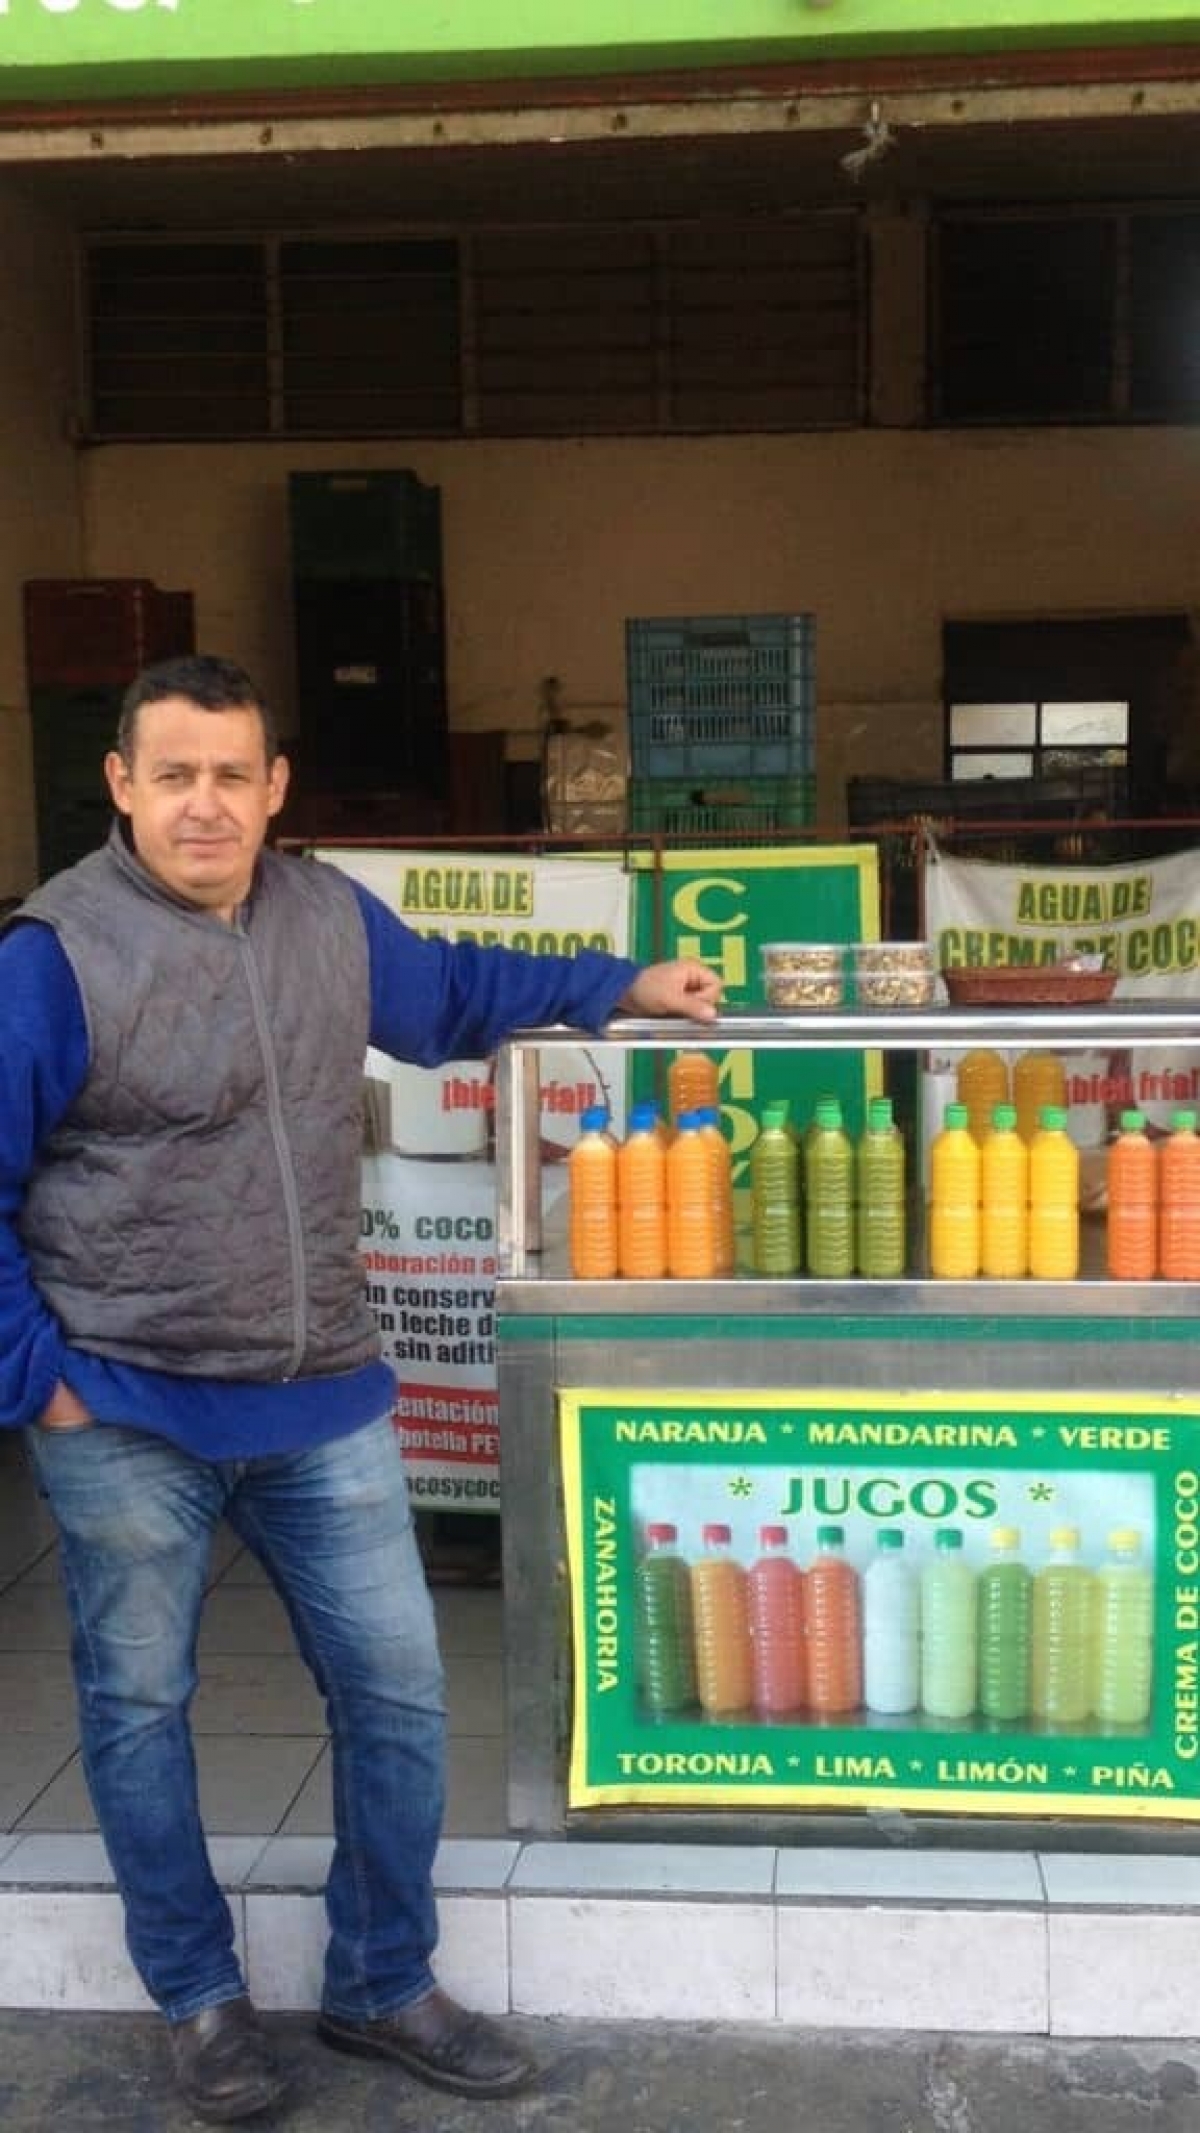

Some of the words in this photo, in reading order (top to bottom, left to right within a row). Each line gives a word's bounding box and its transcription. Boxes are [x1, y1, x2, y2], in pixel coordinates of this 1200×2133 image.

[403, 868, 485, 910] AGUA
[493, 871, 531, 912] DE
[1018, 881, 1101, 921] AGUA
[1112, 878, 1149, 917] DE
[1128, 919, 1200, 971] COC
[361, 1209, 399, 1239] 0%
[415, 1216, 492, 1240] COCO
[393, 1286, 494, 1309] conserv
[400, 1310, 471, 1336] leche
[394, 1337, 430, 1361] sin
[437, 1340, 494, 1364] aditi
[470, 1432, 499, 1455] PE
[615, 1421, 767, 1443] NARANJA
[809, 1423, 1017, 1448] MANDARINA
[1060, 1426, 1172, 1451] VERDE
[781, 1478, 998, 1518] JUGOS
[1174, 1470, 1200, 1575] COCO
[593, 1497, 618, 1693] ZANAHORIA
[1175, 1584, 1200, 1630] DE
[1174, 1642, 1200, 1760] CREMA
[617, 1753, 774, 1776] TORONJA
[816, 1755, 896, 1779] LIMA
[937, 1757, 1048, 1784] LIMÓN
[1092, 1761, 1174, 1789] PIÑA
